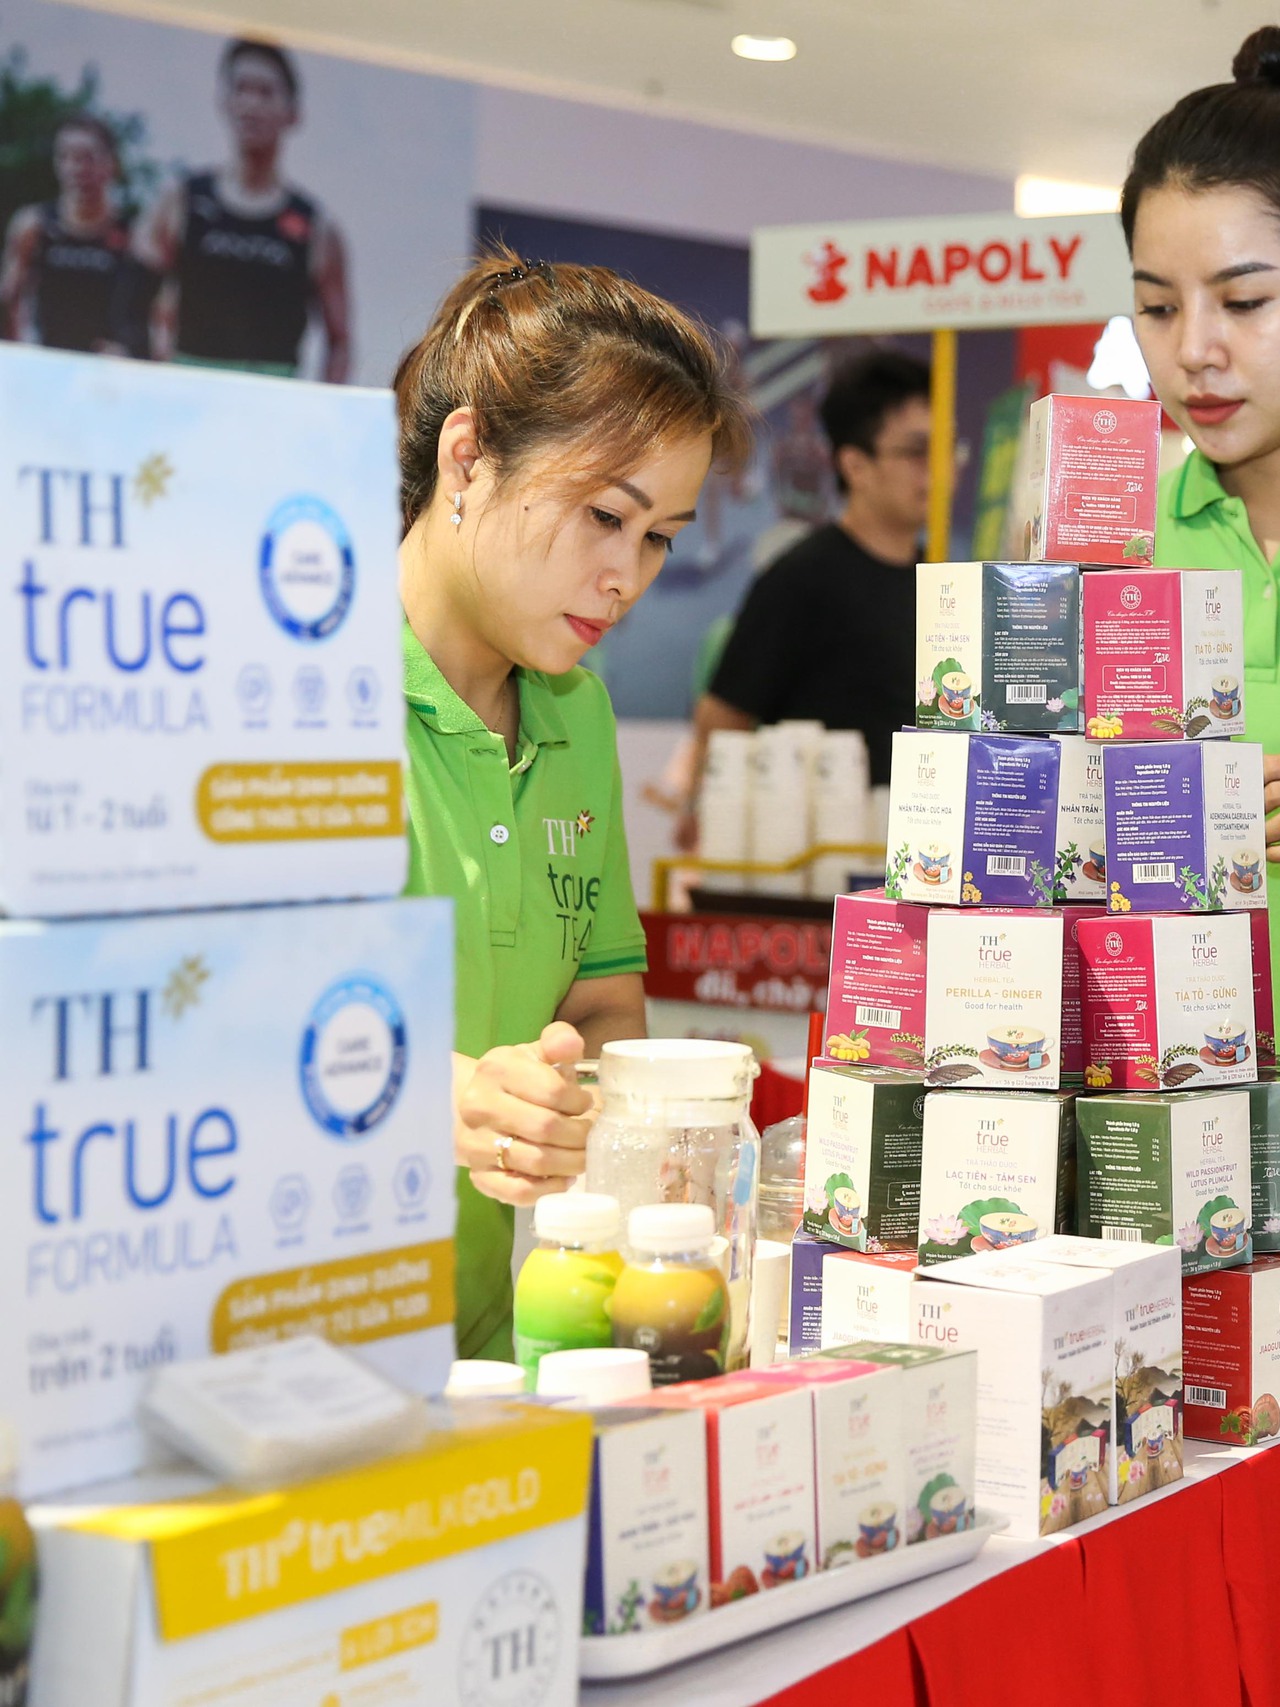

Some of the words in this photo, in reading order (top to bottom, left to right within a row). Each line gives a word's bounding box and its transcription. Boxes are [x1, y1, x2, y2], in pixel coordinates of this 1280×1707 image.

[866, 236, 1081, 289] NAPOLY
[19, 465, 129, 549] TH
[940, 595, 955, 608] true
[1205, 589, 1215, 600] TH
[1205, 602, 1221, 614] true
[14, 559, 207, 675] true
[21, 684, 210, 734] FORMULA
[919, 753, 929, 763] TH
[1088, 755, 1100, 765] TH
[918, 765, 936, 779] true
[1087, 766, 1102, 779] tru
[1225, 764, 1234, 774] TH
[1225, 775, 1240, 789] true
[101, 800, 115, 828] 2
[1061, 804, 1080, 813] NHÂN
[543, 818, 576, 857] TH
[548, 863, 600, 912] true
[979, 935, 998, 946] TH
[1192, 934, 1206, 944] TH
[668, 923, 831, 975] NAPOL
[979, 946, 1012, 962] true
[1192, 945, 1217, 959] true
[979, 961, 1011, 969] HERBAL
[1193, 958, 1218, 967] HERBAL
[946, 988, 991, 998] PERILLA
[1002, 990, 1042, 999] GINGER
[1175, 989, 1190, 1001] TÍA
[1192, 987, 1204, 1000] TÔ
[1213, 986, 1237, 999] GỪNG
[964, 1001, 984, 1010] Good
[986, 1002, 997, 1010] for
[999, 1003, 1023, 1011] health
[1218, 1001, 1231, 1010] khỏe
[30, 986, 153, 1083] TH
[833, 1096, 842, 1107] TH
[833, 1106, 848, 1123] true
[978, 1120, 995, 1130] TH
[1202, 1120, 1214, 1132] TH
[976, 1131, 1009, 1146] true
[1202, 1132, 1223, 1147] true
[976, 1145, 1008, 1154] HERBAL
[24, 1103, 239, 1226] true
[1186, 1170, 1200, 1179] WILD
[1201, 1163, 1238, 1176] PASSIONFRUIT
[966, 1170, 987, 1180] TIÊN
[996, 1172, 1014, 1182] TÂM
[1017, 1175, 1036, 1183] SEN
[1190, 1179, 1208, 1188] LOTUS
[1209, 1174, 1233, 1185] PLUMULA
[960, 1181, 971, 1189] Tốt
[1004, 1184, 1022, 1193] khỏe
[1195, 1188, 1207, 1196] Good
[1215, 1185, 1229, 1193] health
[26, 1213, 240, 1298] FORMULA
[857, 1285, 869, 1296] TH
[857, 1296, 878, 1313] true
[919, 1304, 940, 1319] TH
[1125, 1309, 1135, 1322] TH
[918, 1319, 958, 1343] true
[1054, 1337, 1064, 1350] TH
[100, 1345, 115, 1376] 2
[219, 1538, 280, 1600] TH
[483, 1623, 535, 1680] TH
